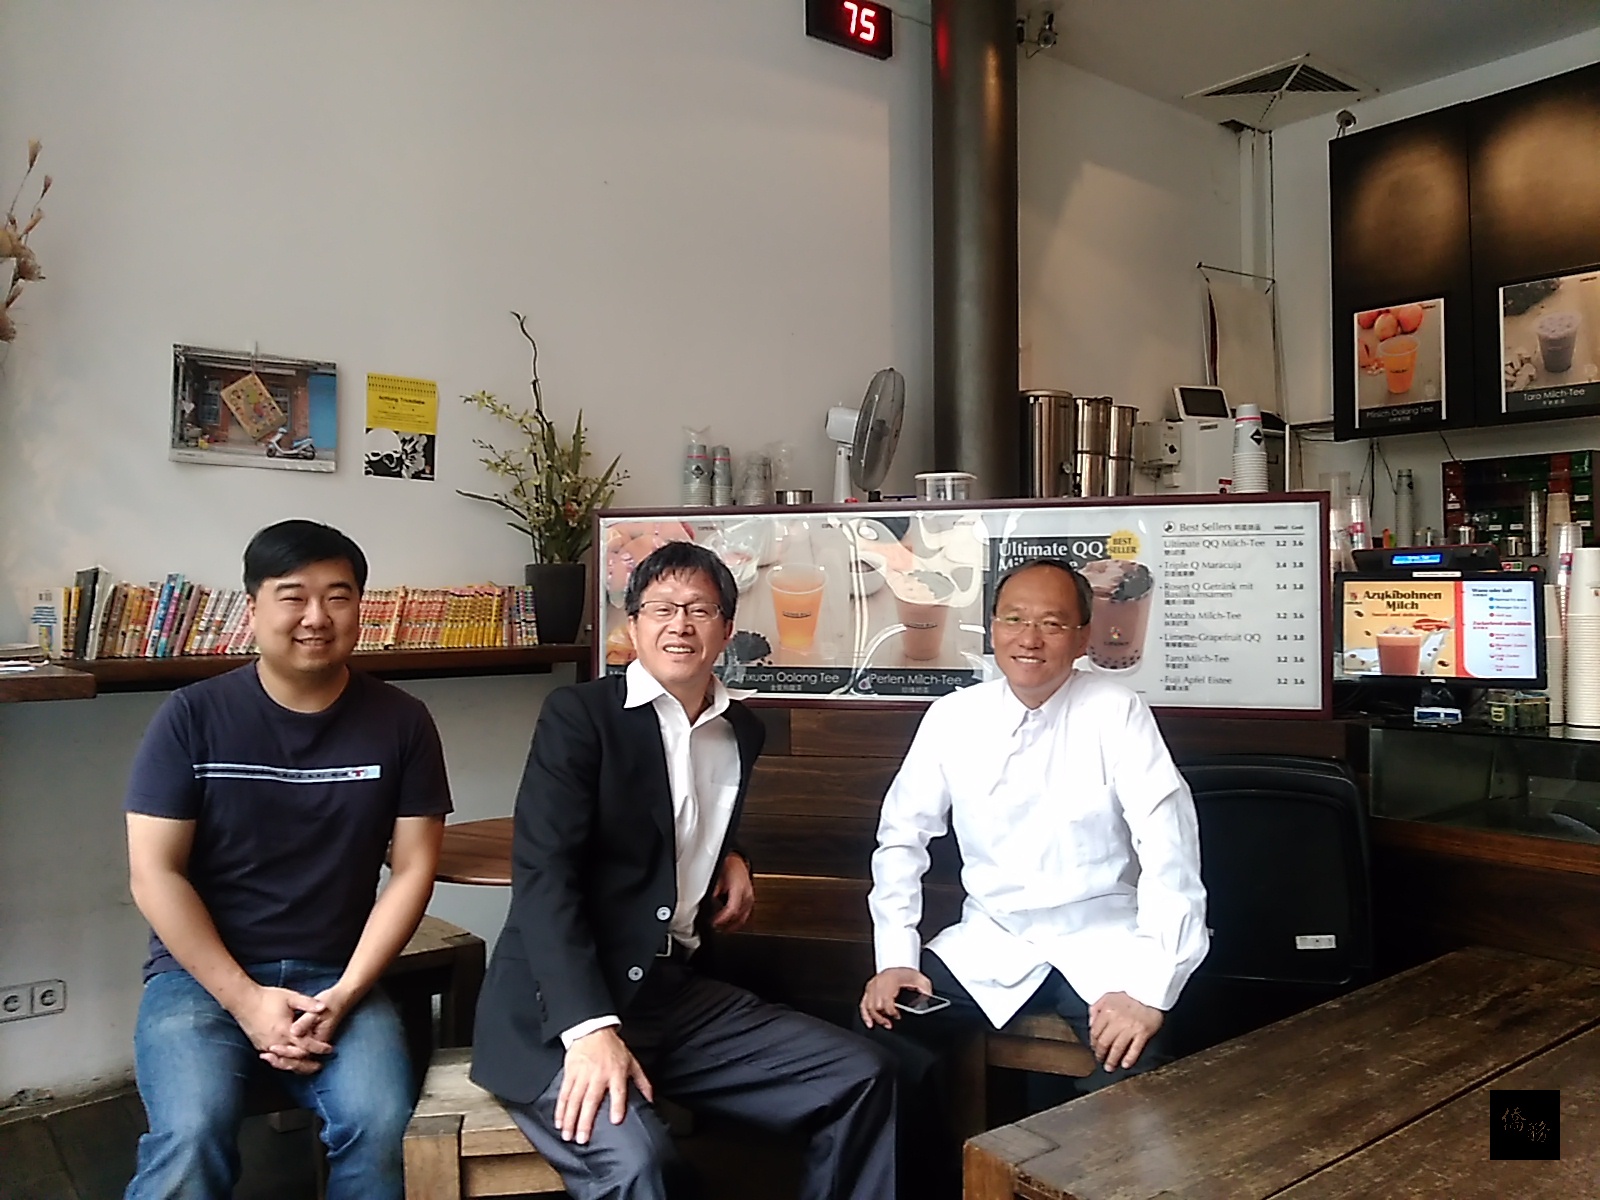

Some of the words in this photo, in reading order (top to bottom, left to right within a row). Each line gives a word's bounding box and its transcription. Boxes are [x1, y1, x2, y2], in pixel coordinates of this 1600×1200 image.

[843, 1, 876, 41] 75
[1523, 393, 1541, 401] Taro
[1543, 388, 1585, 399] Milch-Tee
[1179, 523, 1199, 531] Best
[1202, 522, 1232, 531] Sellers
[1113, 537, 1132, 545] BEST
[1164, 540, 1200, 548] Ultimate
[1202, 540, 1219, 549] QQ
[1221, 539, 1265, 547] Milch-Tee
[999, 541, 1068, 556] Ultimate
[1072, 541, 1104, 559] QQ
[1109, 545, 1137, 554] SELLER
[1164, 561, 1189, 570] Triple
[1190, 561, 1200, 570] Q
[1201, 561, 1242, 571] Maracuja
[1164, 582, 1190, 590] Rosen
[1191, 582, 1200, 591] Q
[1386, 600, 1419, 611] Milch
[1244, 633, 1262, 643] QQ
[1165, 654, 1184, 662] Taro
[1186, 654, 1230, 662] Milch-Tee
[776, 671, 817, 685] Oolong
[820, 672, 840, 683] Tee
[869, 673, 905, 684] Perlen
[907, 673, 962, 685] Milch-Tee
[1164, 676, 1181, 684] Fuji
